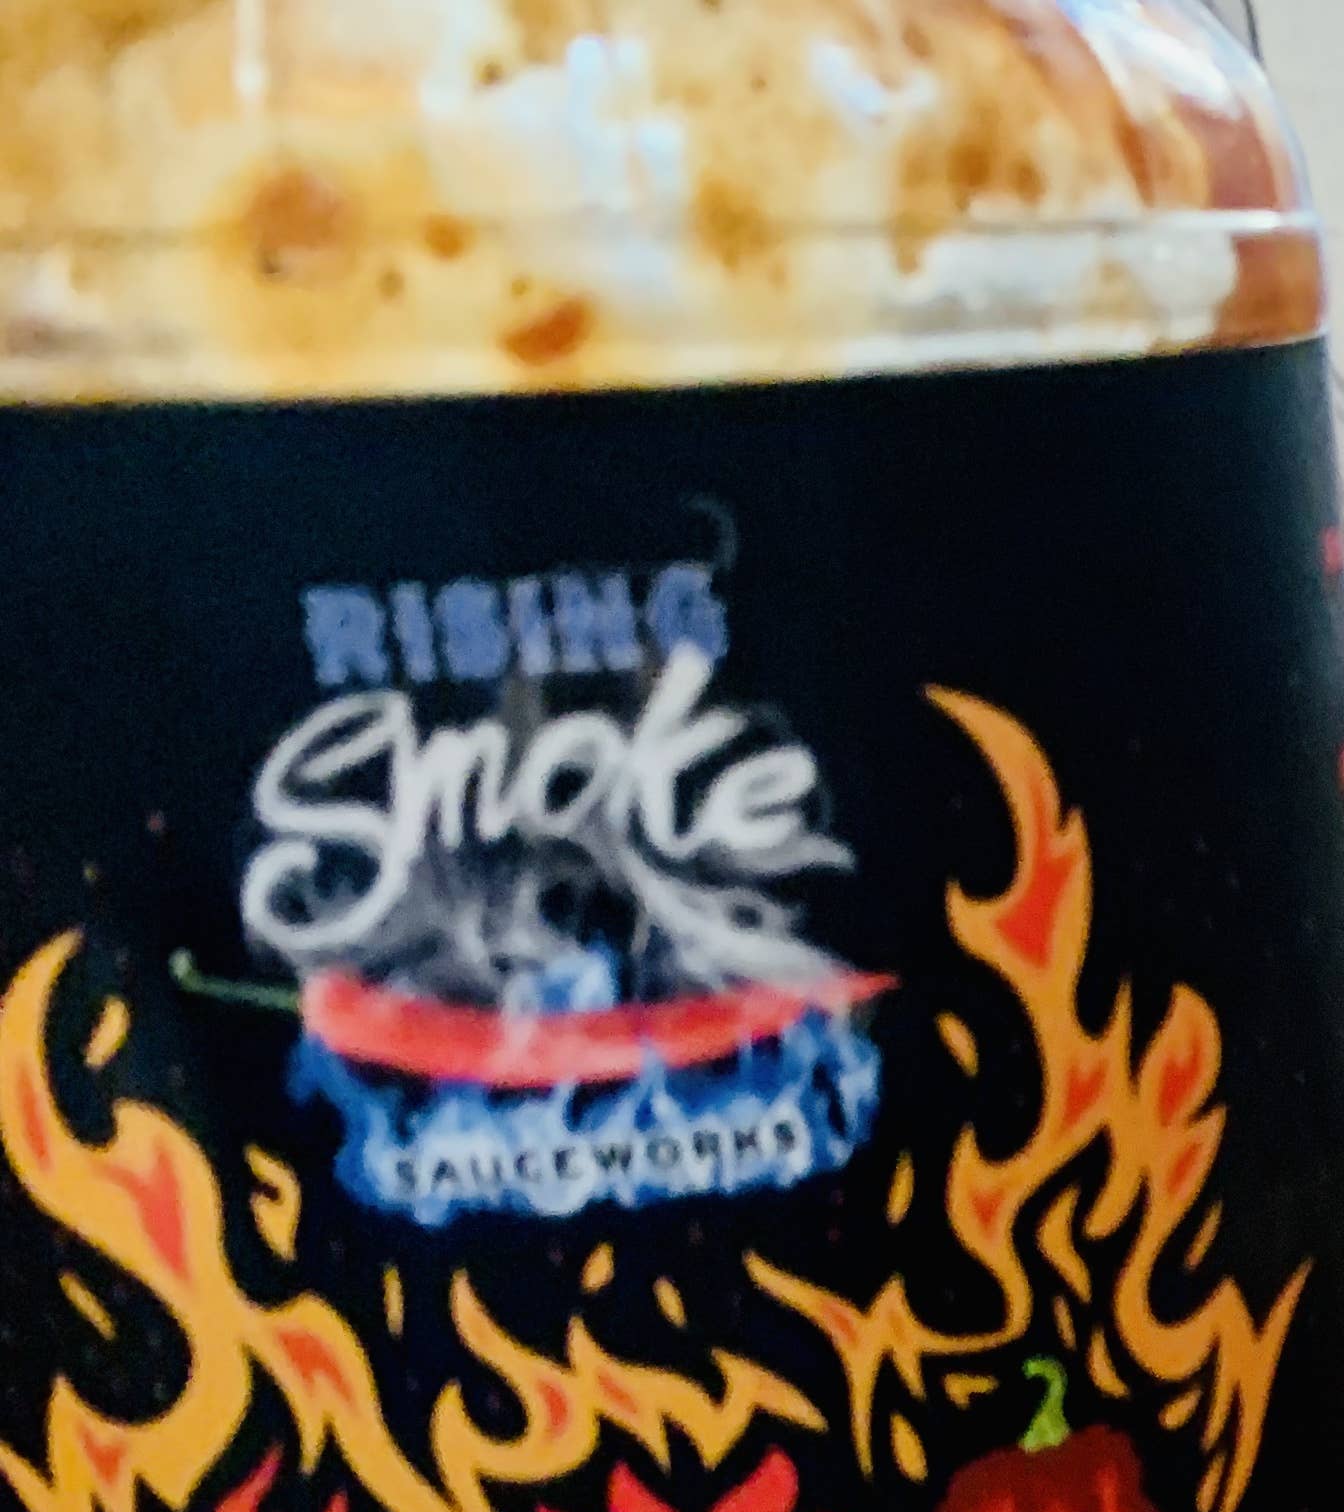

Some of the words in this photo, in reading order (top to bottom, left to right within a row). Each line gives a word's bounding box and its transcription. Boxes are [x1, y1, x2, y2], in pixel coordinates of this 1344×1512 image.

[303, 563, 727, 684] RISING
[242, 645, 850, 950] Smoke
[394, 1119, 801, 1191] SAUCEWORKS
